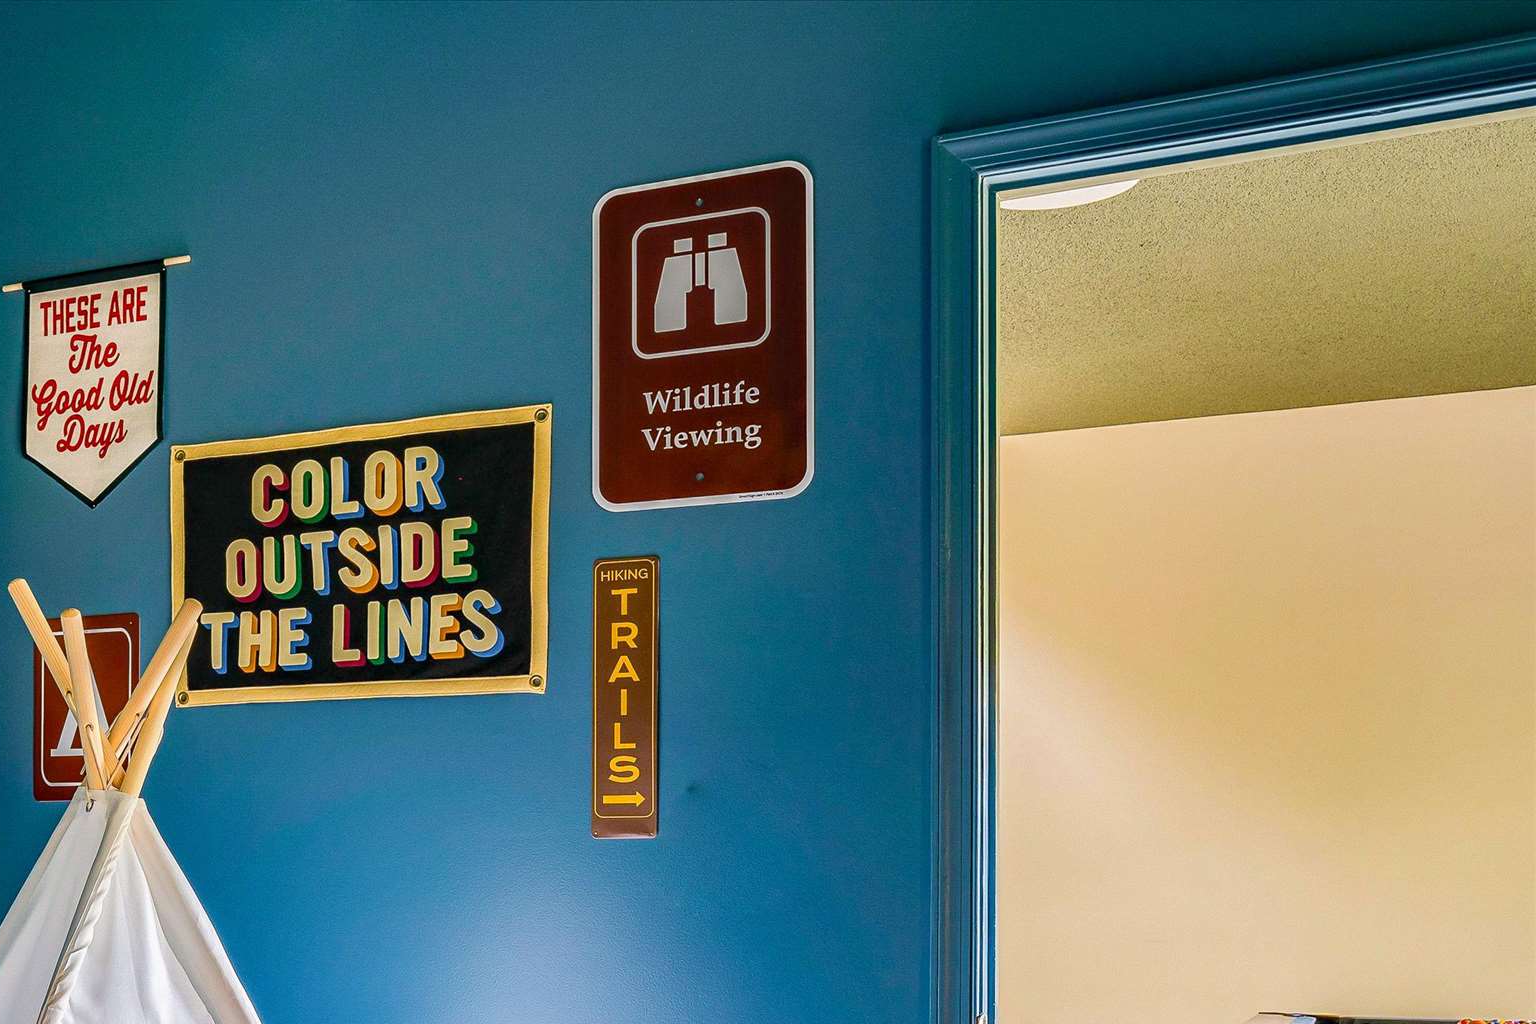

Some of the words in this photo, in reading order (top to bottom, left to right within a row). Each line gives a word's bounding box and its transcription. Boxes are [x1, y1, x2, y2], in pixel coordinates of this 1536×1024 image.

[40, 294, 102, 336] THESE
[107, 286, 148, 327] ARE
[68, 334, 120, 374] The
[31, 377, 104, 431] Good
[109, 369, 155, 411] Old
[643, 380, 760, 415] Wildlife
[56, 414, 127, 459] Days
[641, 420, 762, 451] Viewing
[251, 445, 446, 527] COLOR
[225, 516, 478, 603] OUTSIDE
[600, 568, 649, 582] HIKING
[200, 607, 313, 674] THE
[332, 589, 505, 667] LINES
[607, 587, 641, 783] TRAILS
